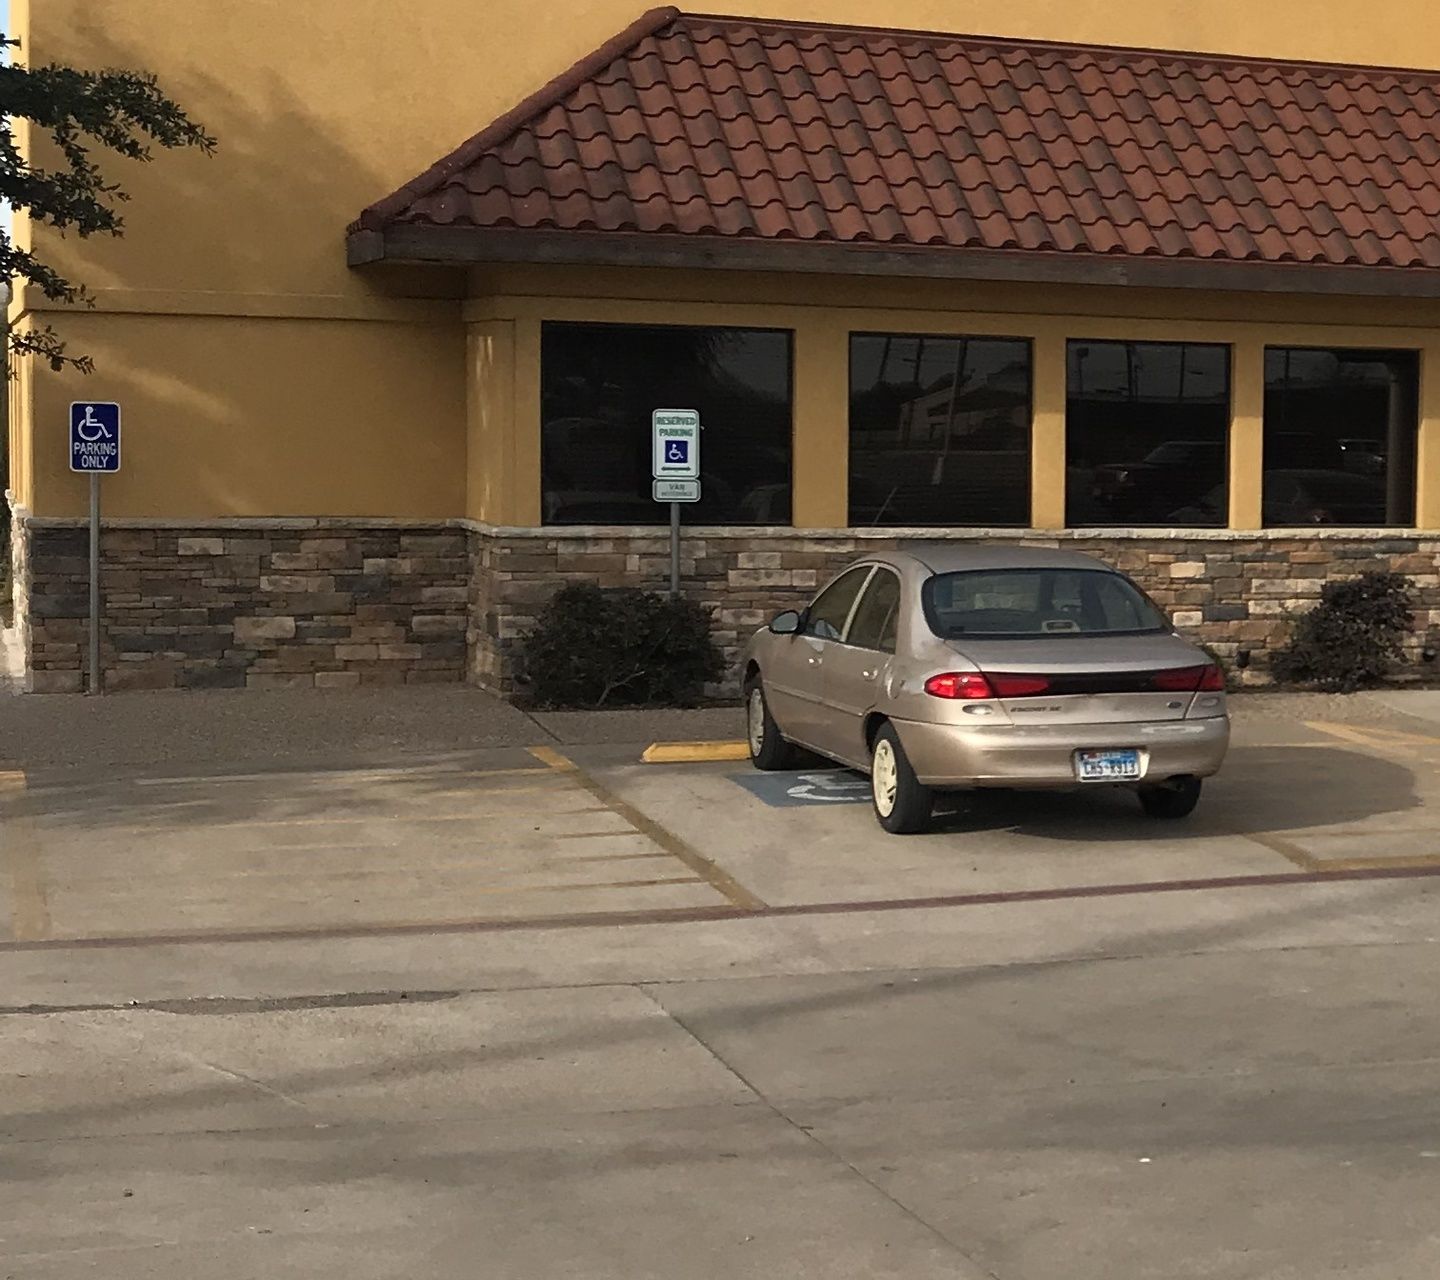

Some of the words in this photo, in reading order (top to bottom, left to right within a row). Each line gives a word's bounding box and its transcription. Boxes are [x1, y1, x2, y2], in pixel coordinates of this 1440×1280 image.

[656, 416, 696, 426] RESERVED
[659, 428, 693, 437] PARKING
[73, 442, 116, 455] PARKING
[81, 455, 109, 468] ONLY
[669, 483, 685, 491] VAN
